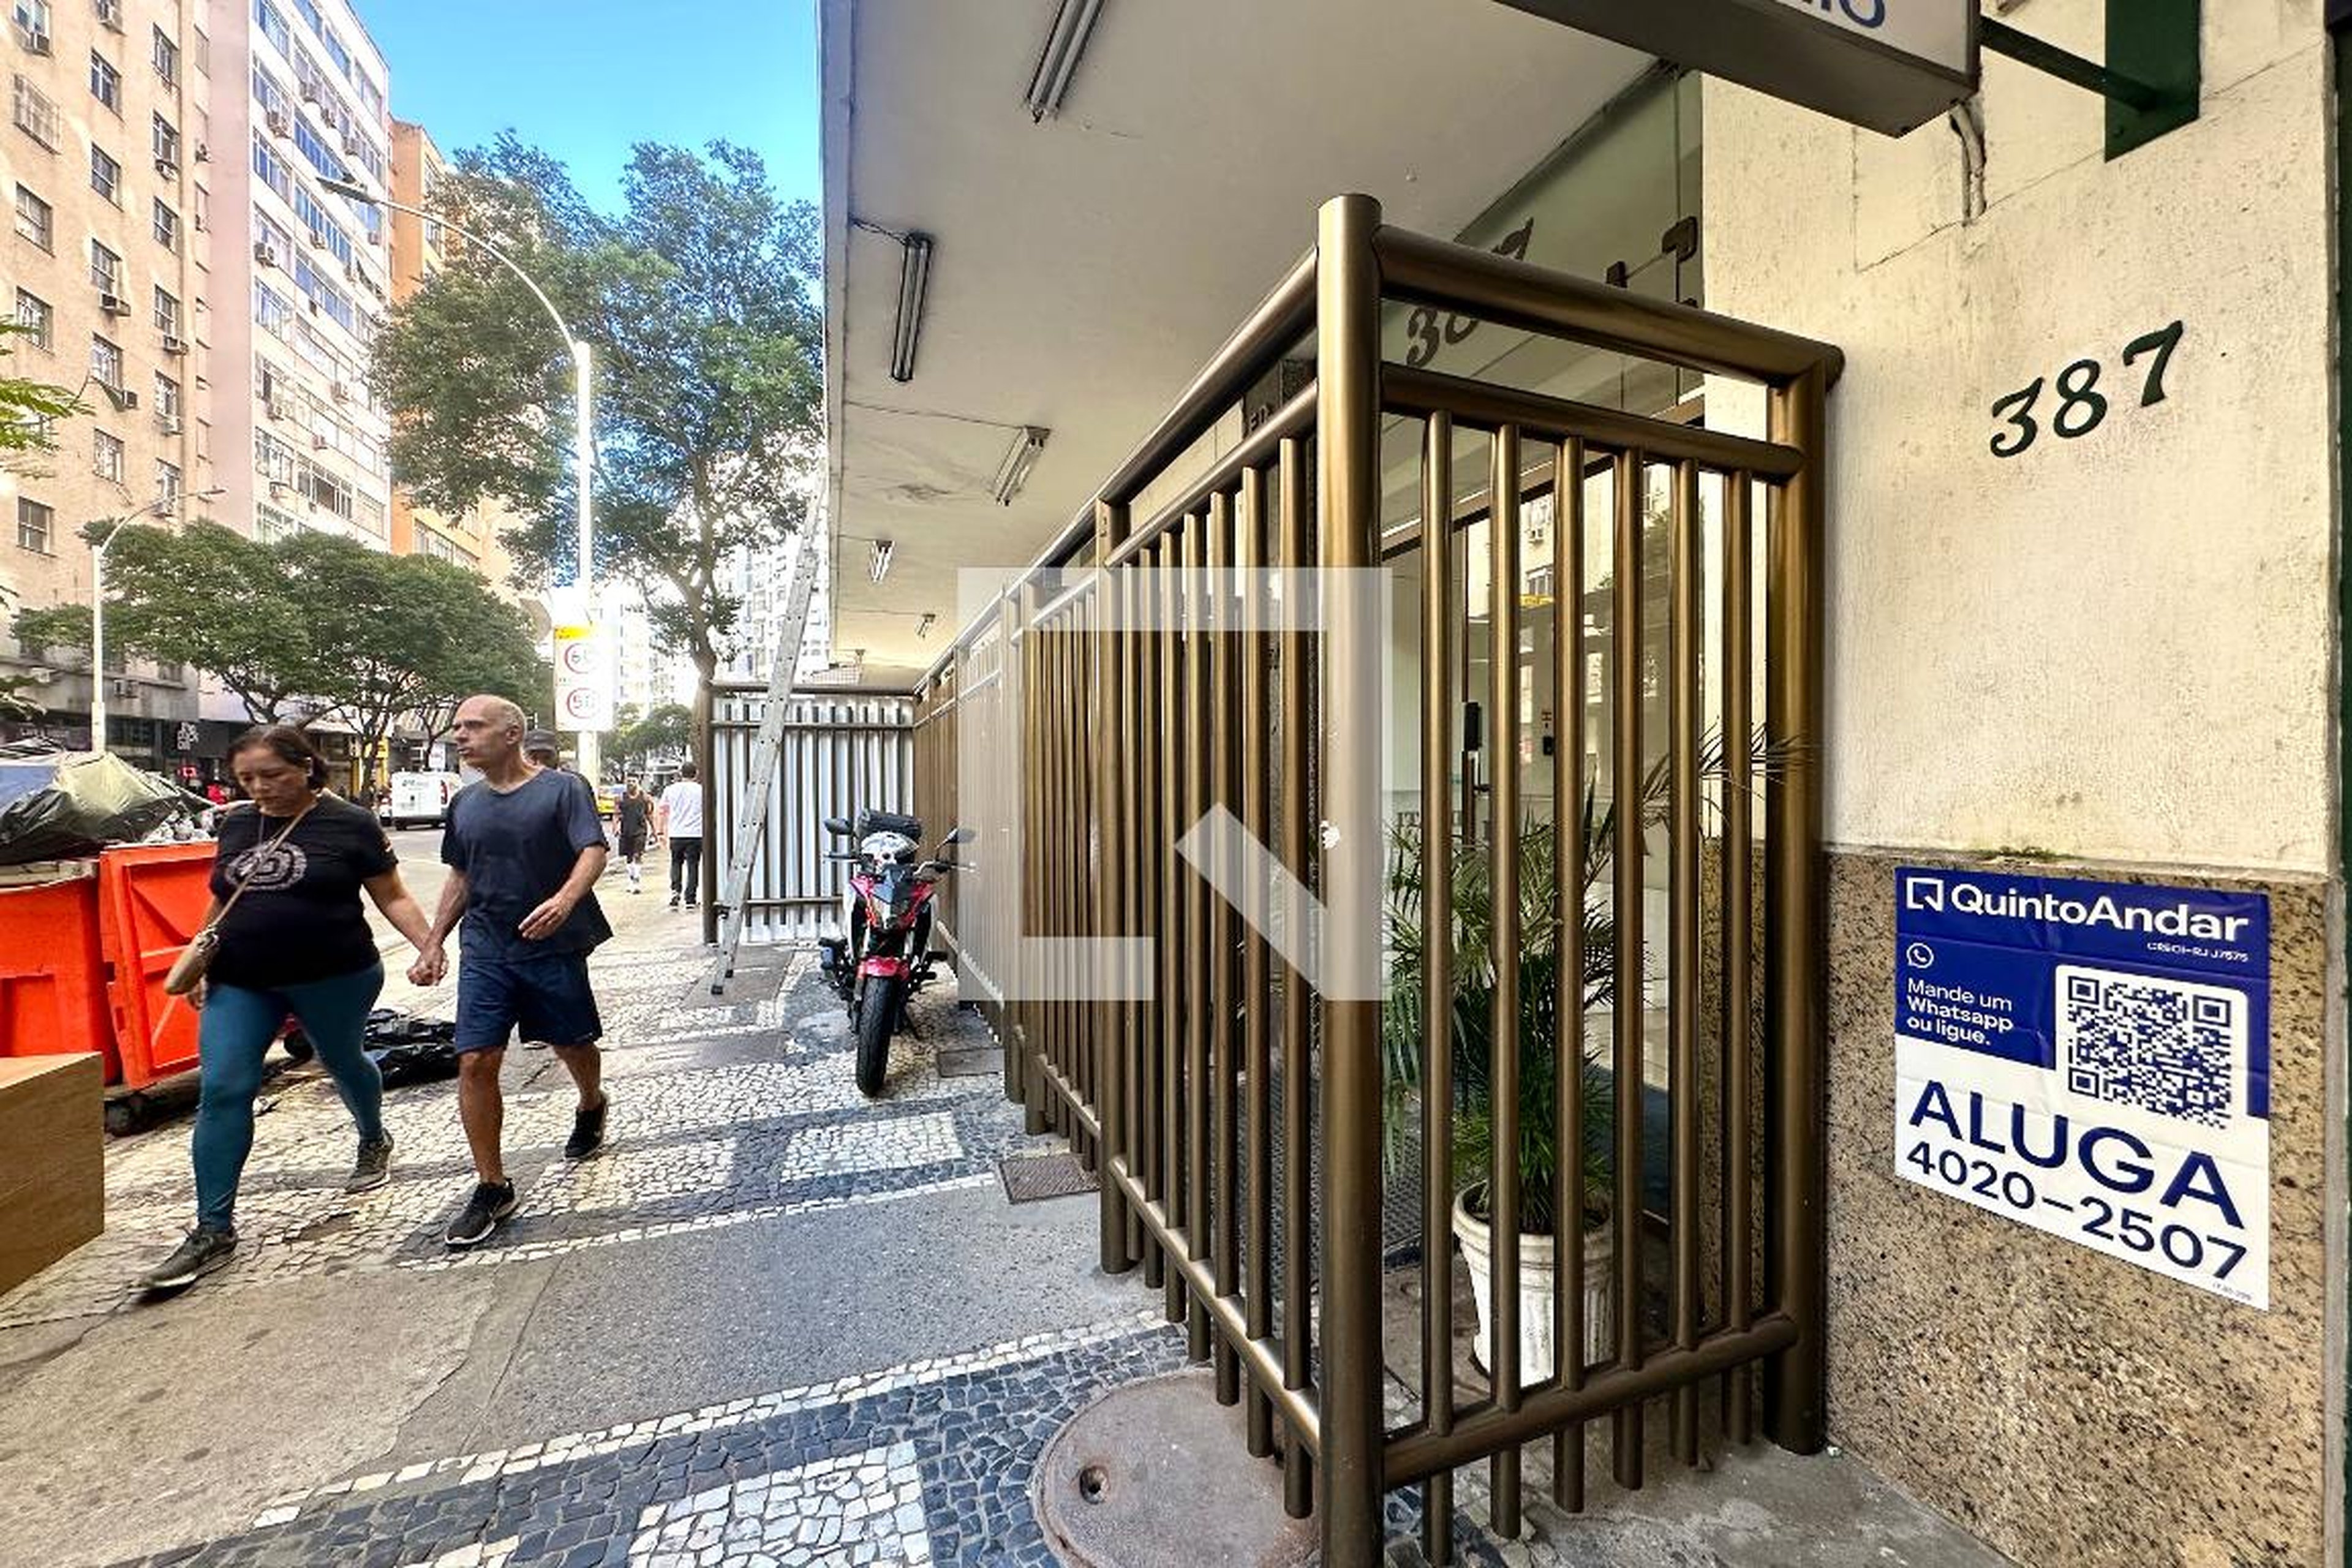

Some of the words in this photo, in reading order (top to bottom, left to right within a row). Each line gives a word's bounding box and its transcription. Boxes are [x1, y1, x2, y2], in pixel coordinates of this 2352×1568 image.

[1990, 320, 2183, 458] 387
[1951, 883, 2248, 941] QuintoAndar
[1907, 995, 2013, 1033] Whatsapp
[1908, 978, 1974, 1004] Mande
[1979, 993, 2013, 1011] um
[1907, 1017, 1932, 1031] ou
[1936, 1019, 1991, 1046] ligue.
[1909, 1079, 2244, 1229] ALUGA
[1907, 1141, 2247, 1280] 4020-2507
